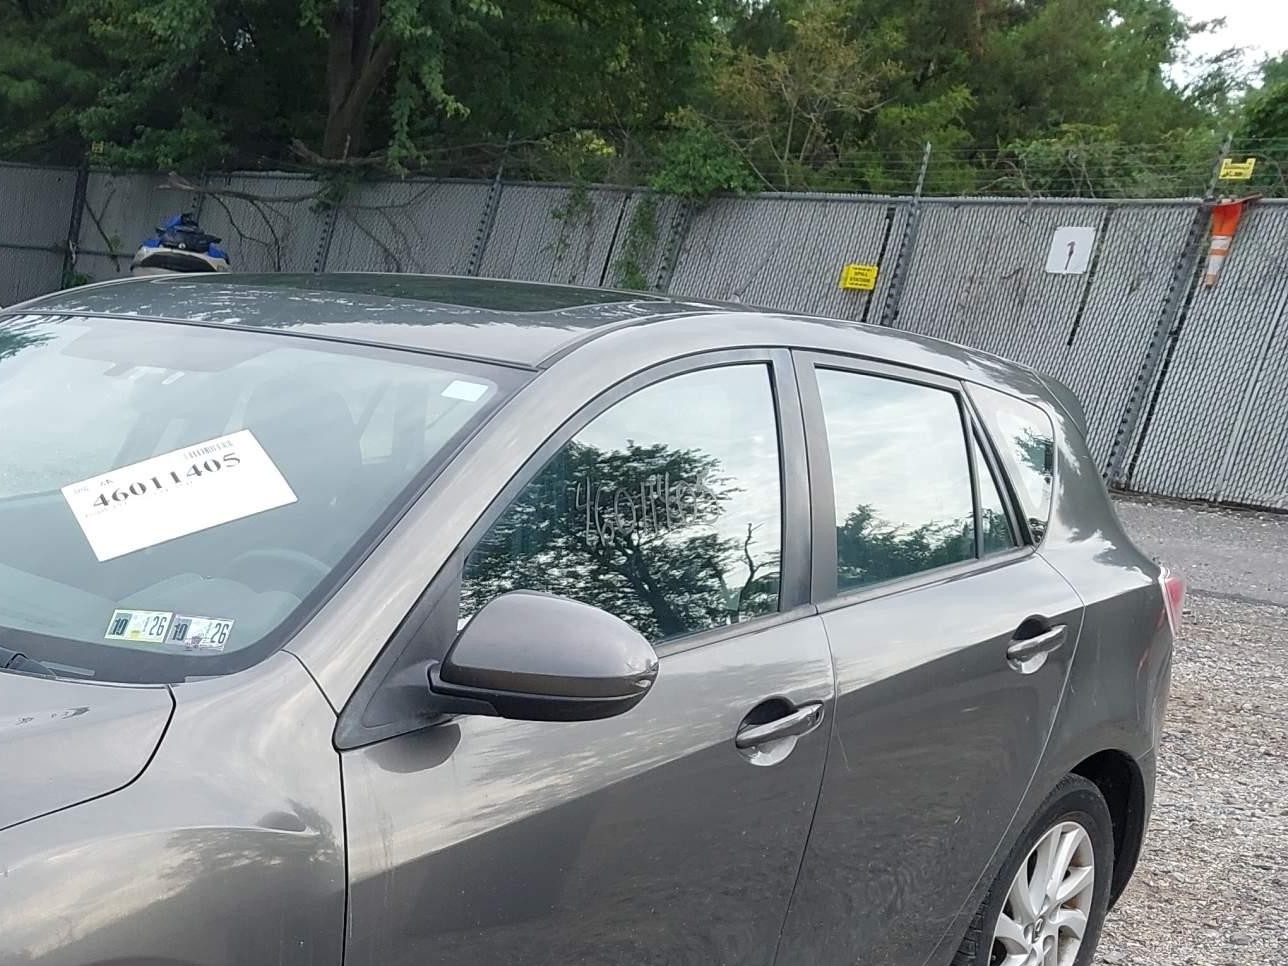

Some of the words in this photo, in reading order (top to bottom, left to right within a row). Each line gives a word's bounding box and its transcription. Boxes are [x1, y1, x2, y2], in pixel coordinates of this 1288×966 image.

[92, 452, 241, 508] 46011405
[149, 615, 168, 636] 26
[211, 622, 230, 644] 26
